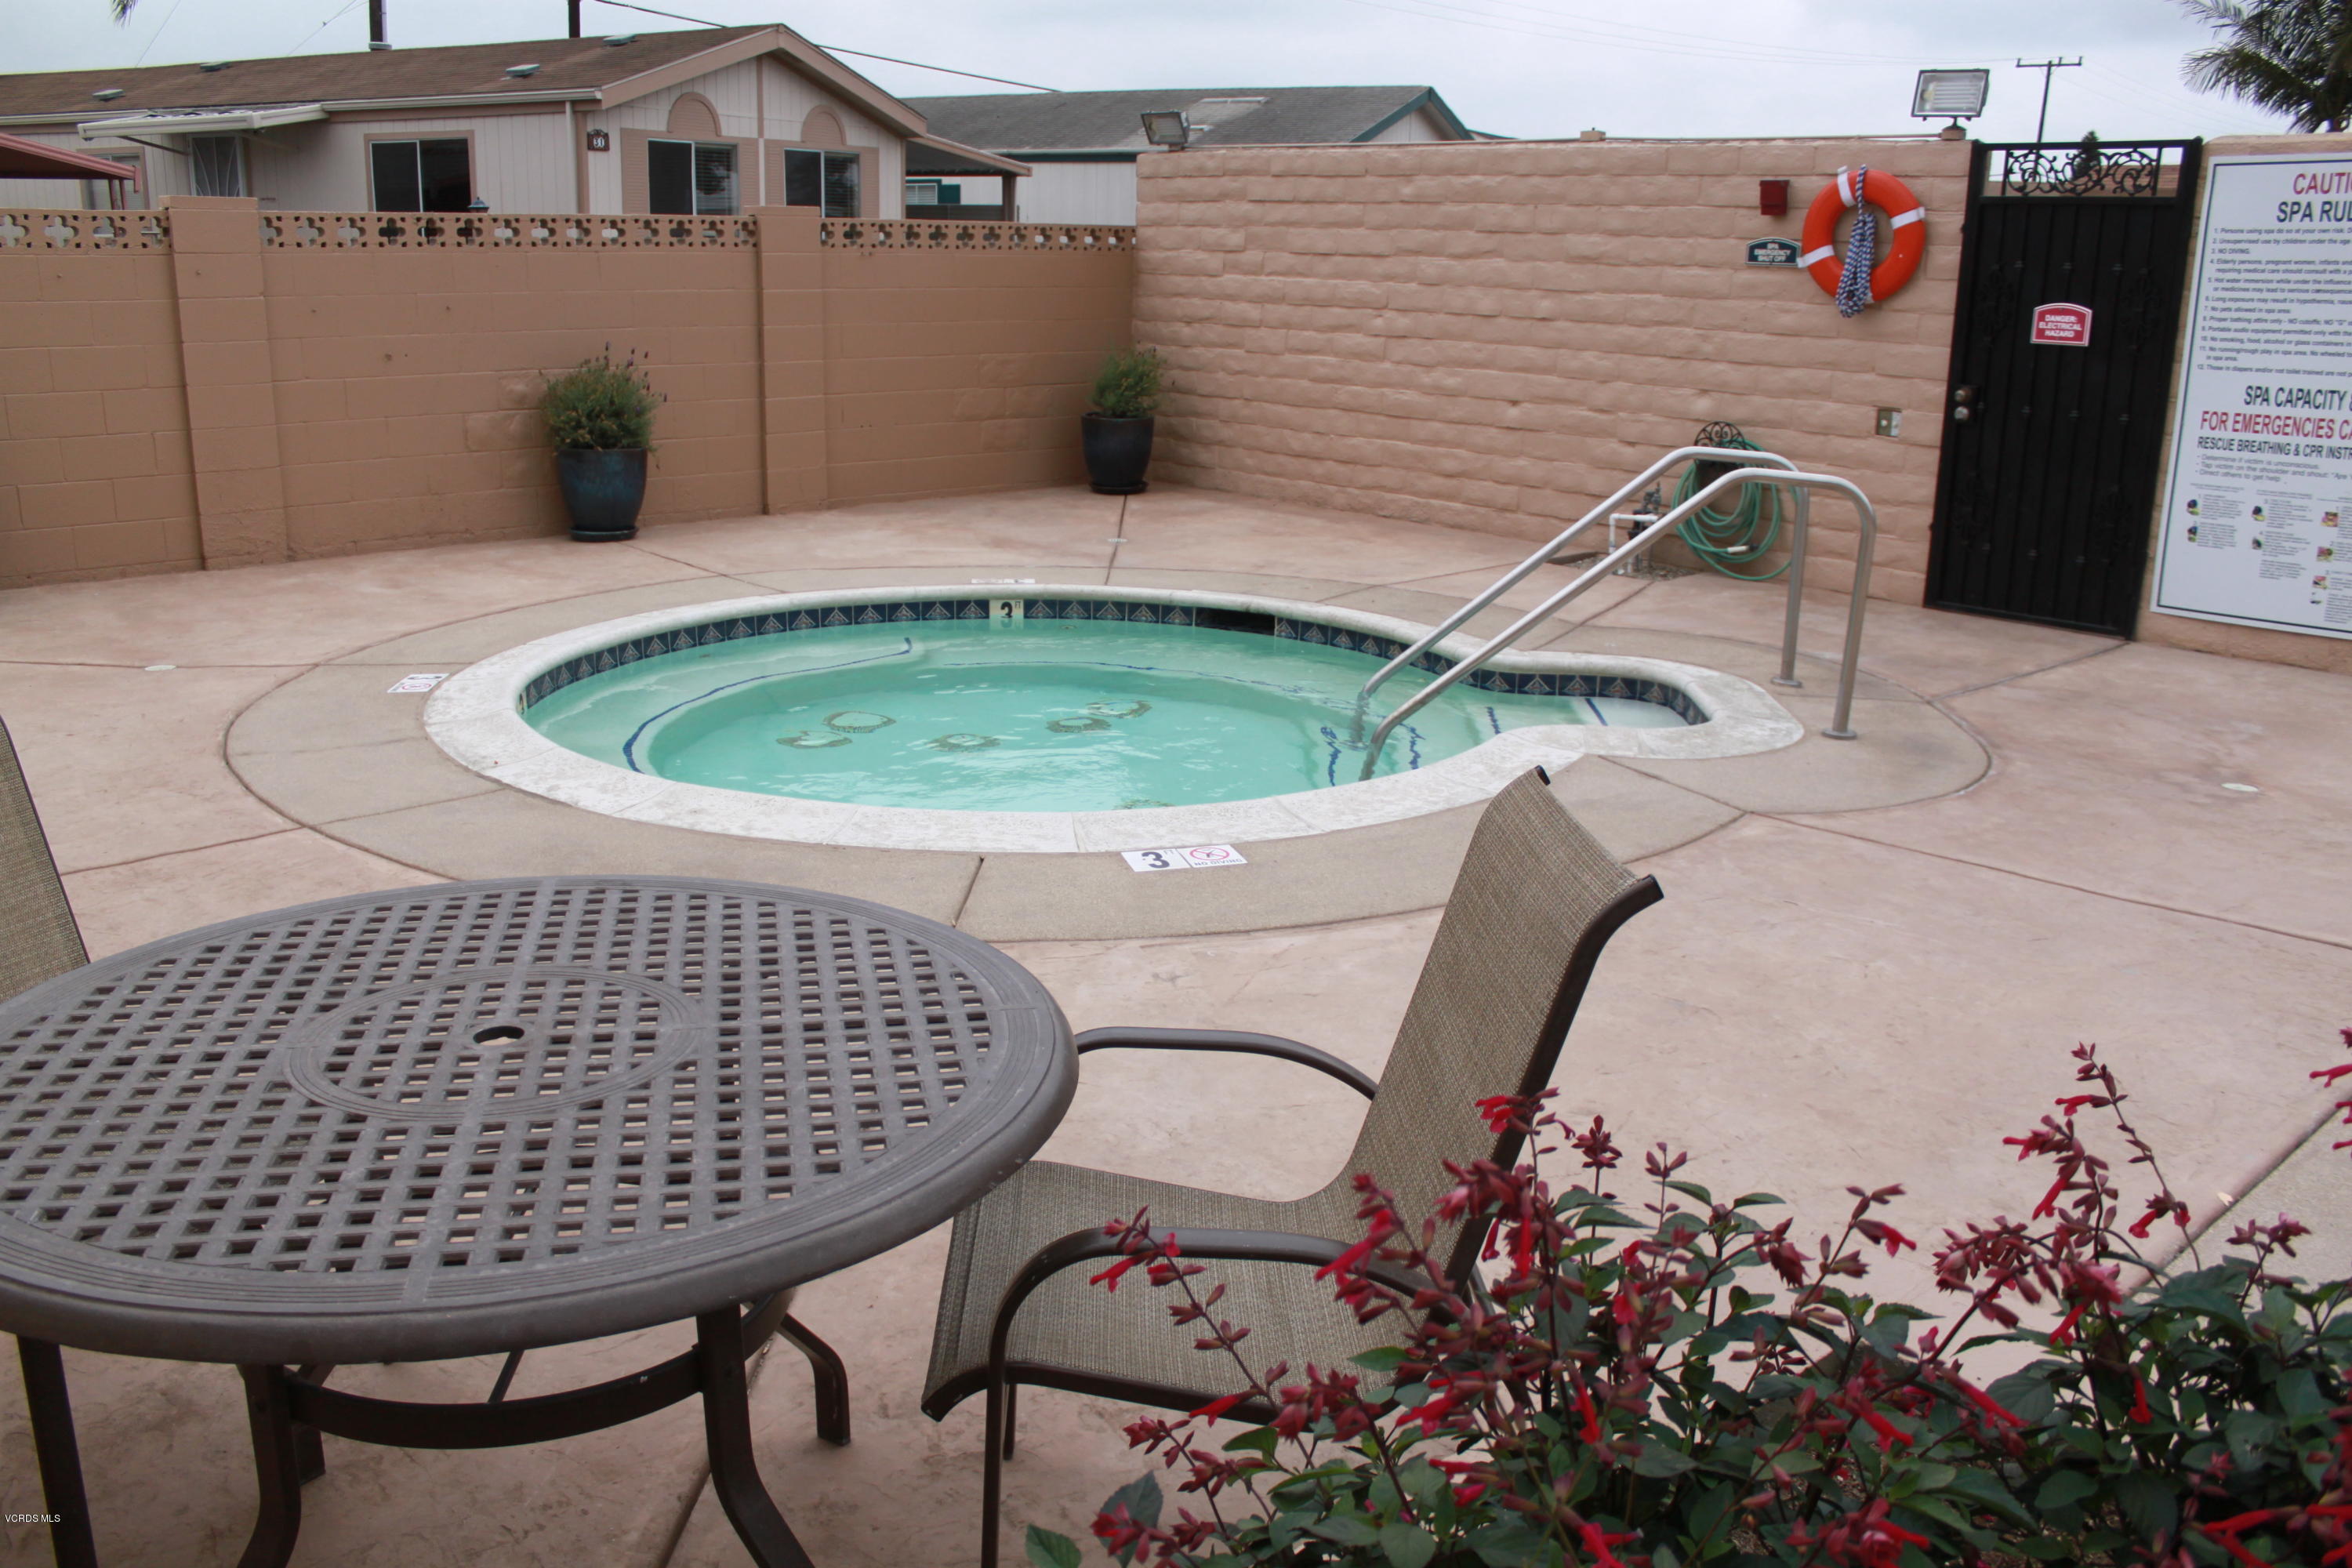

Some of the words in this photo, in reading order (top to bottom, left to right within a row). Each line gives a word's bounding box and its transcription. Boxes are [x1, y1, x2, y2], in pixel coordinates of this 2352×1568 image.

[2293, 172, 2352, 195] CAUTI
[2277, 201, 2313, 223] SPA
[2038, 321, 2082, 330] ELECTRICAL
[2244, 385, 2270, 406] SPA
[2274, 387, 2347, 410] CAPACITY
[2200, 411, 2229, 432] FOR
[2232, 412, 2336, 439] EMERGENCIES
[2198, 436, 2236, 452] RESCUE
[2237, 439, 2290, 456] BREATHING
[2293, 444, 2300, 456] &
[2303, 444, 2323, 458] CPR
[1141, 851, 1170, 869] 3
